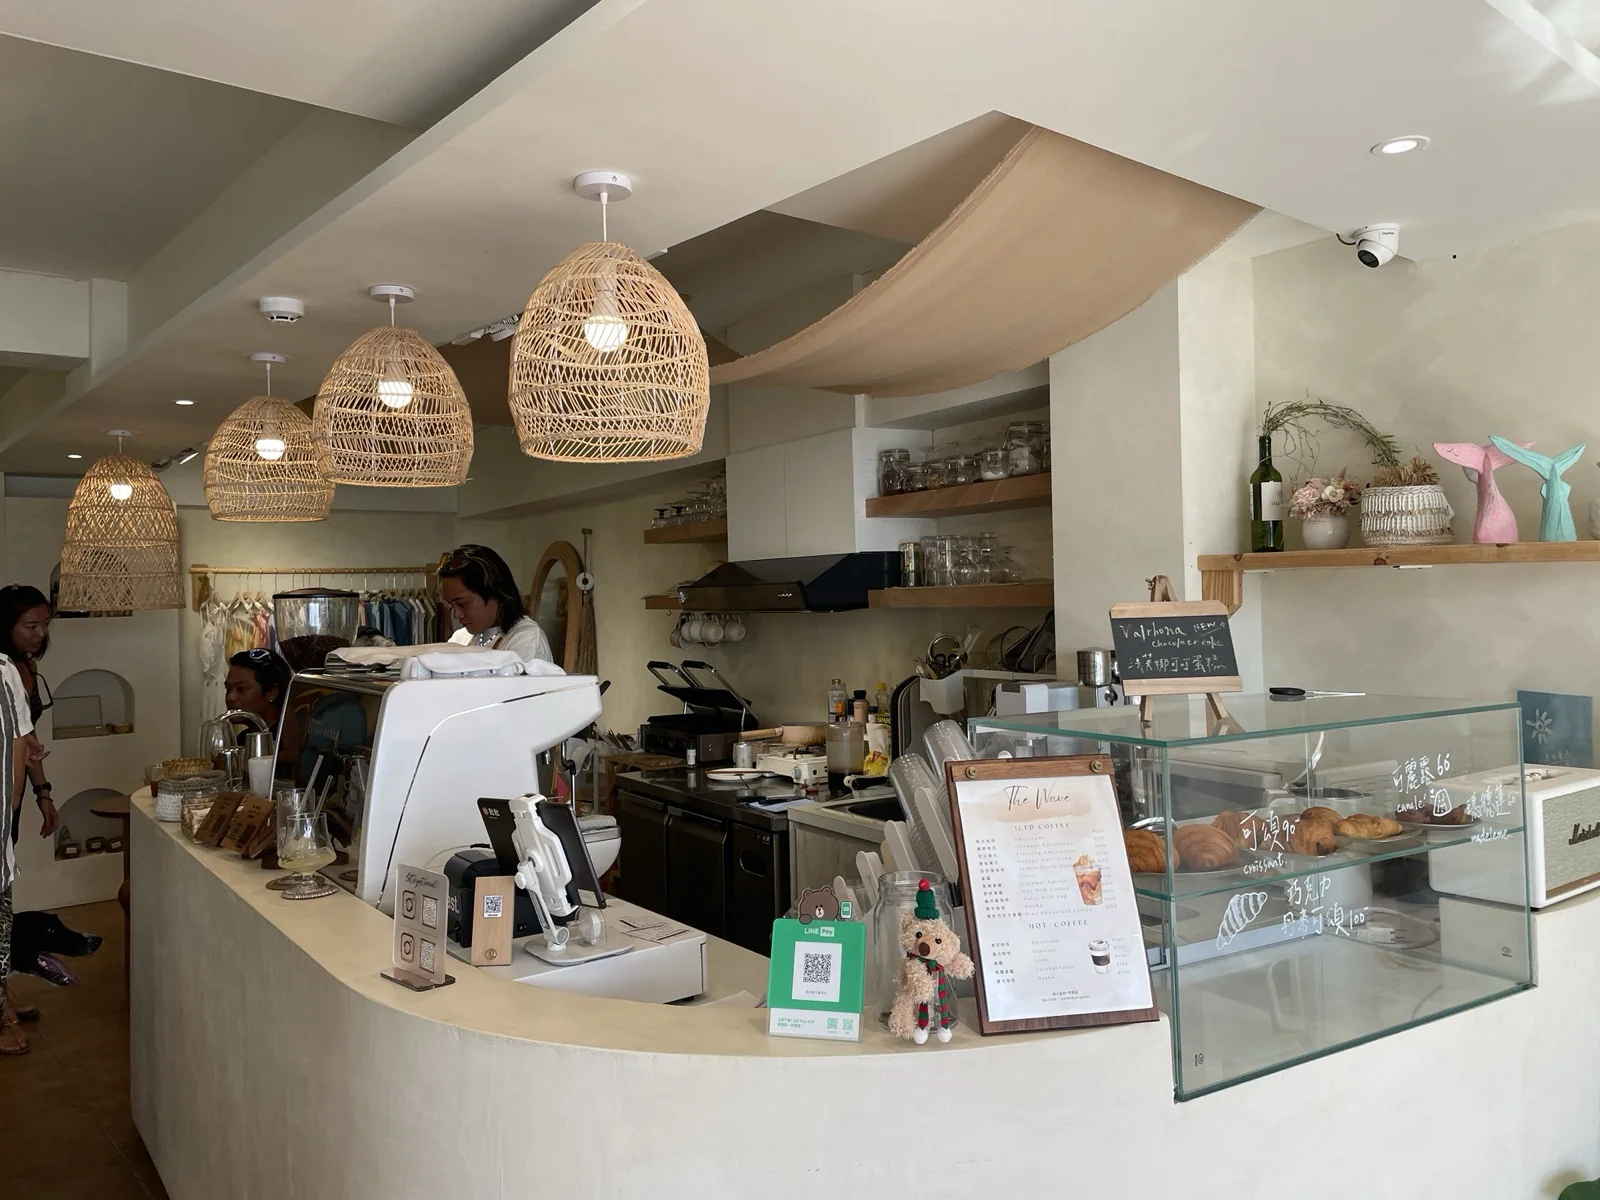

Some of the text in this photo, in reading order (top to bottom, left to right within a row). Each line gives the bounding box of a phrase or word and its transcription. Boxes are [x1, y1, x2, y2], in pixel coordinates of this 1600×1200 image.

[1119, 621, 1216, 641] Valrhona NEW
[1003, 780, 1072, 811] The Wave
[1014, 822, 1070, 832] ICED COFFEE
[1028, 919, 1089, 930] HOT COFFEE
[804, 927, 834, 937] LINE Pay
